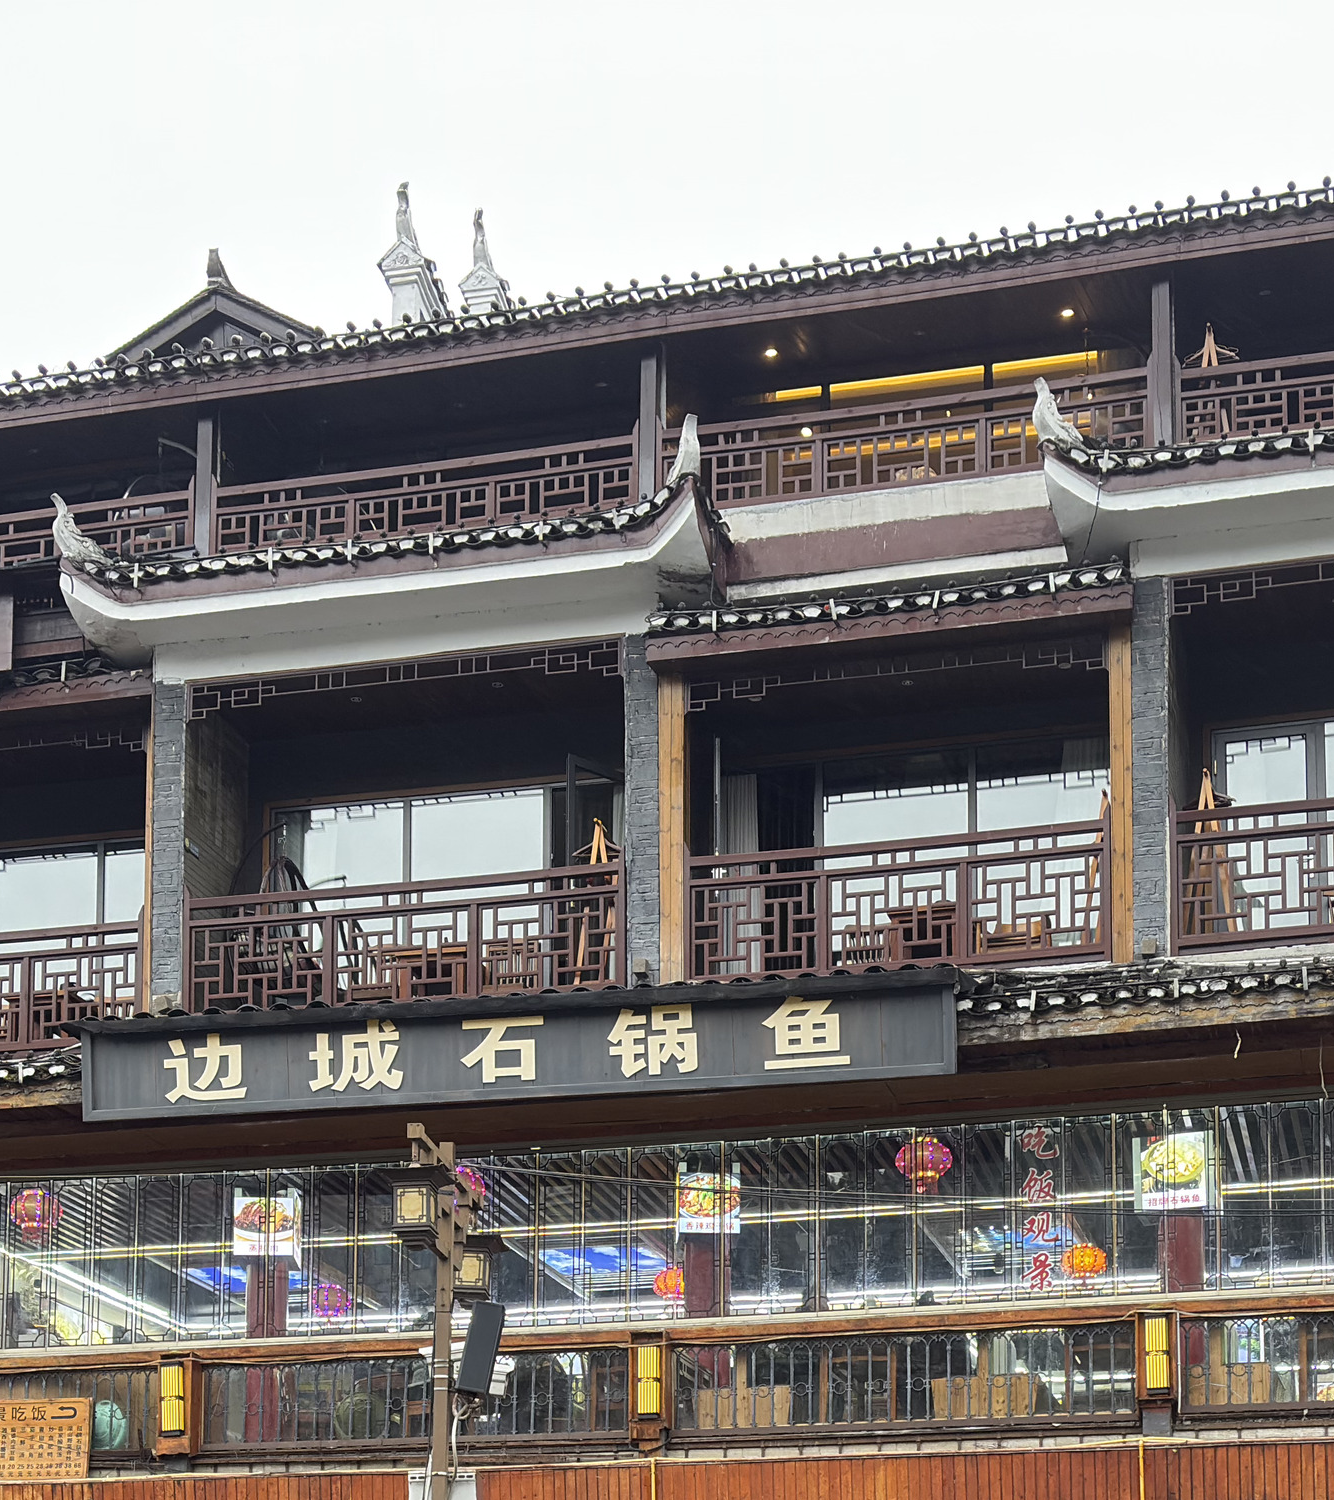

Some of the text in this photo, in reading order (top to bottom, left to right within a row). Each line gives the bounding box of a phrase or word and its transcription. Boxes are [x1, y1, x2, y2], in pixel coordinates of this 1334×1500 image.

[164, 995, 851, 1104] 边城石锅鱼
[1019, 1125, 1060, 1292] 吃饭观景
